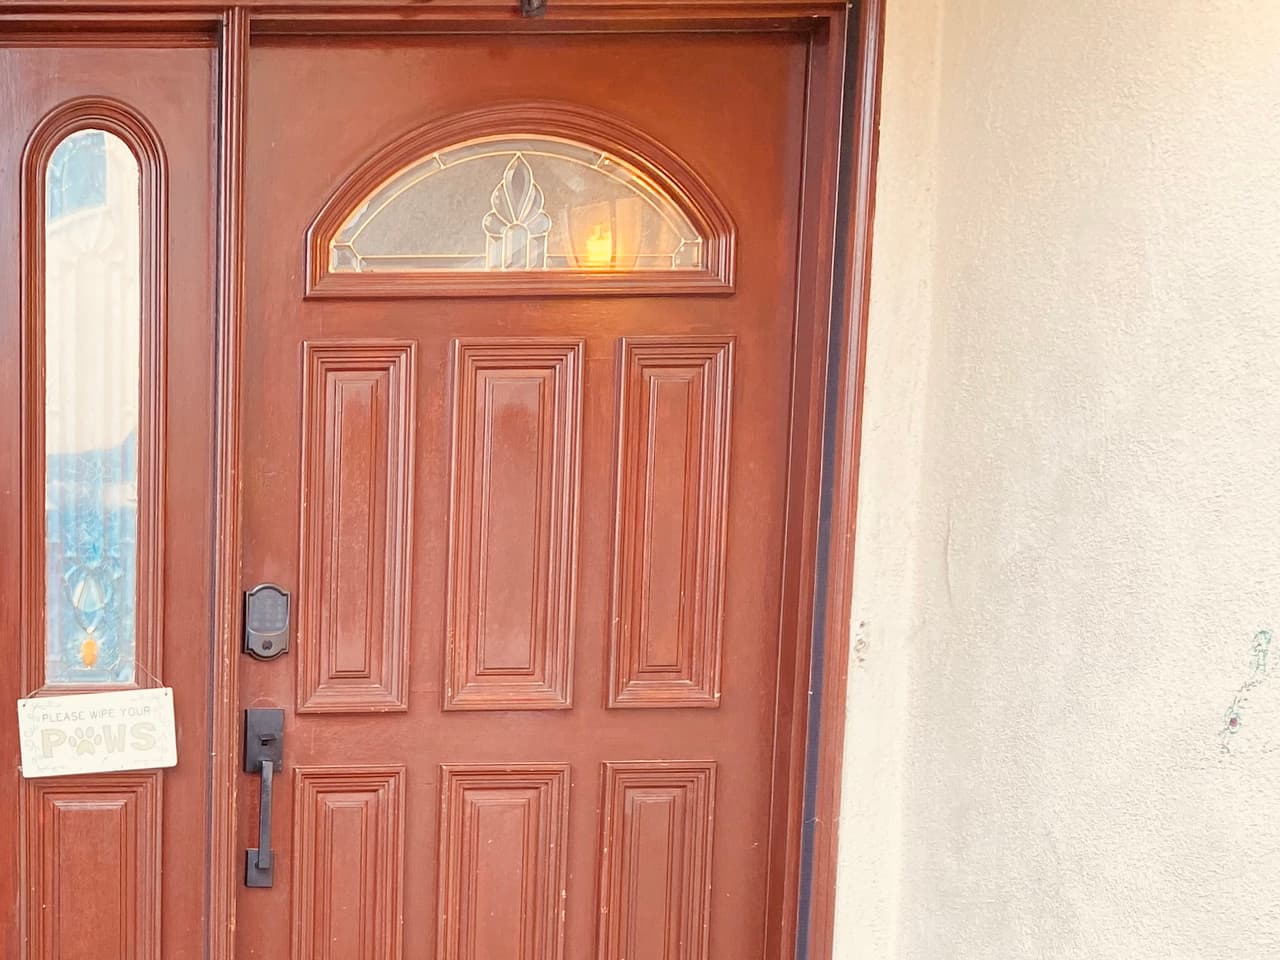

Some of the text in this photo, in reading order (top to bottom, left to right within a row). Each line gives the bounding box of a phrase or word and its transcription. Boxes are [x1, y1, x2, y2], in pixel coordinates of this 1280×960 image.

[41, 706, 151, 722] PLEASE WIPE YOUR
[40, 722, 157, 758] PWS
